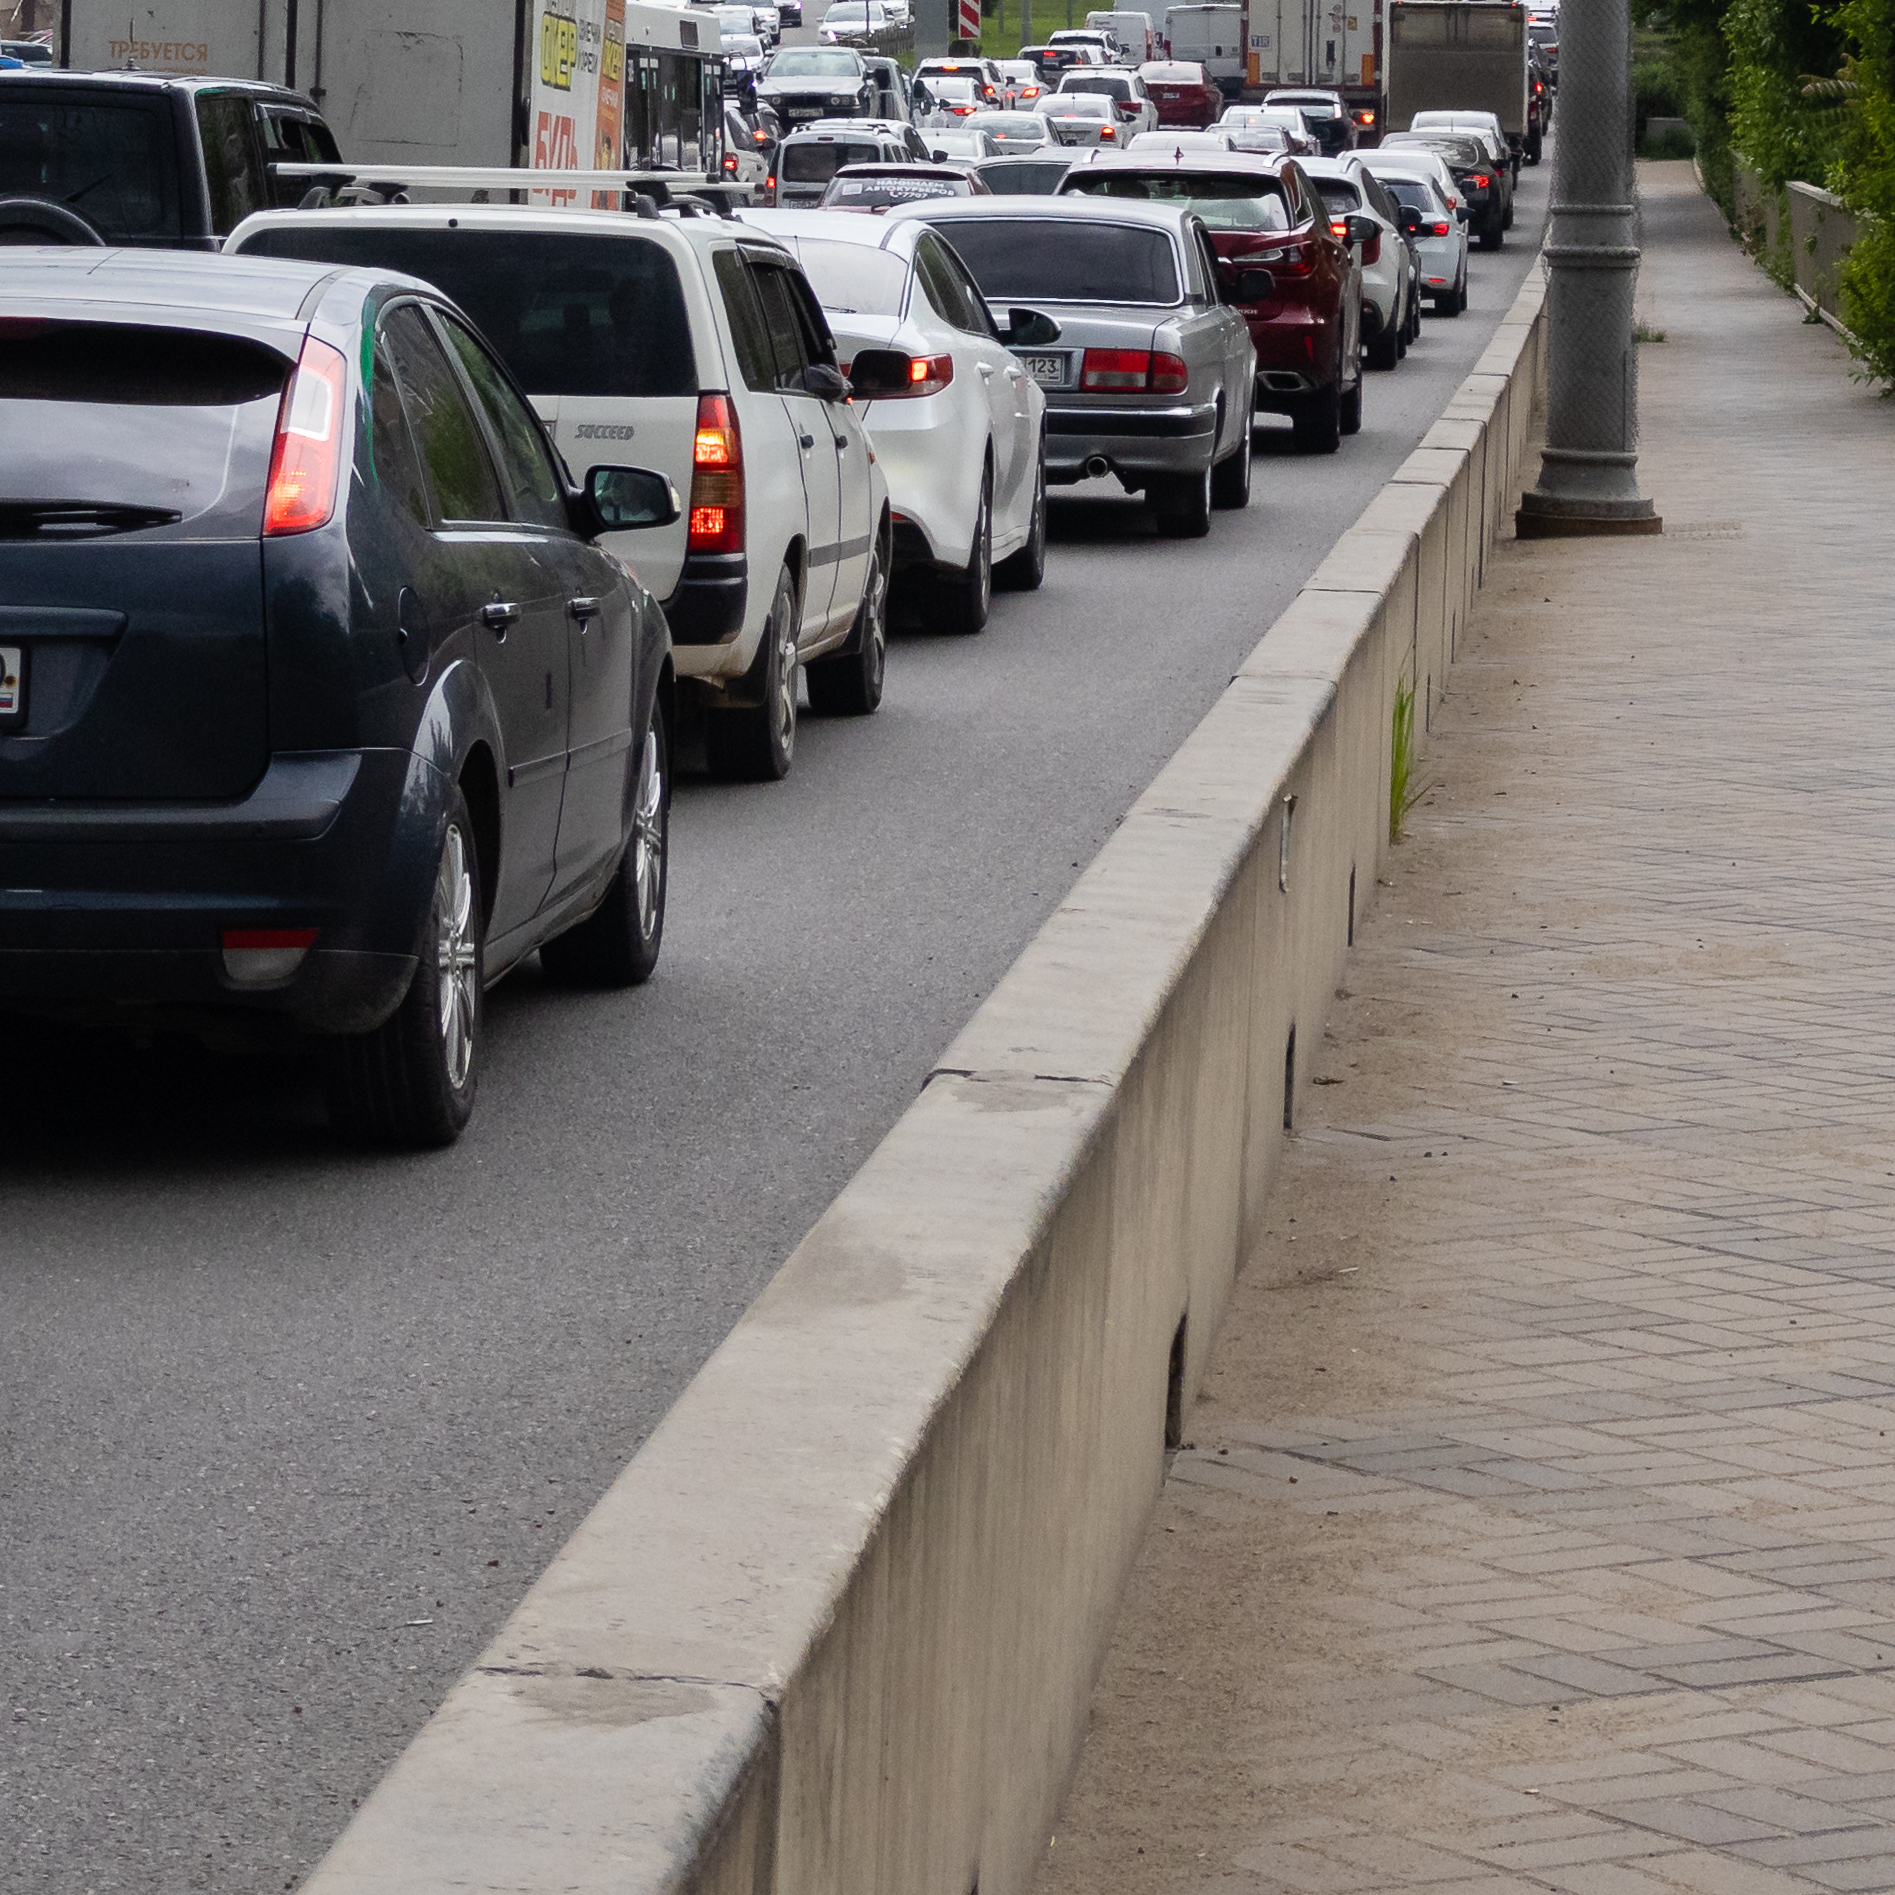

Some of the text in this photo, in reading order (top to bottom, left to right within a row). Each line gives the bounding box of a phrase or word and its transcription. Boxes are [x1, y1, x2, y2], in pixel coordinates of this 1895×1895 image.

[109, 41, 208, 61] ТРЕБУЕТСЯ
[1028, 358, 1057, 373] 123
[574, 424, 634, 440] SUCCEED
